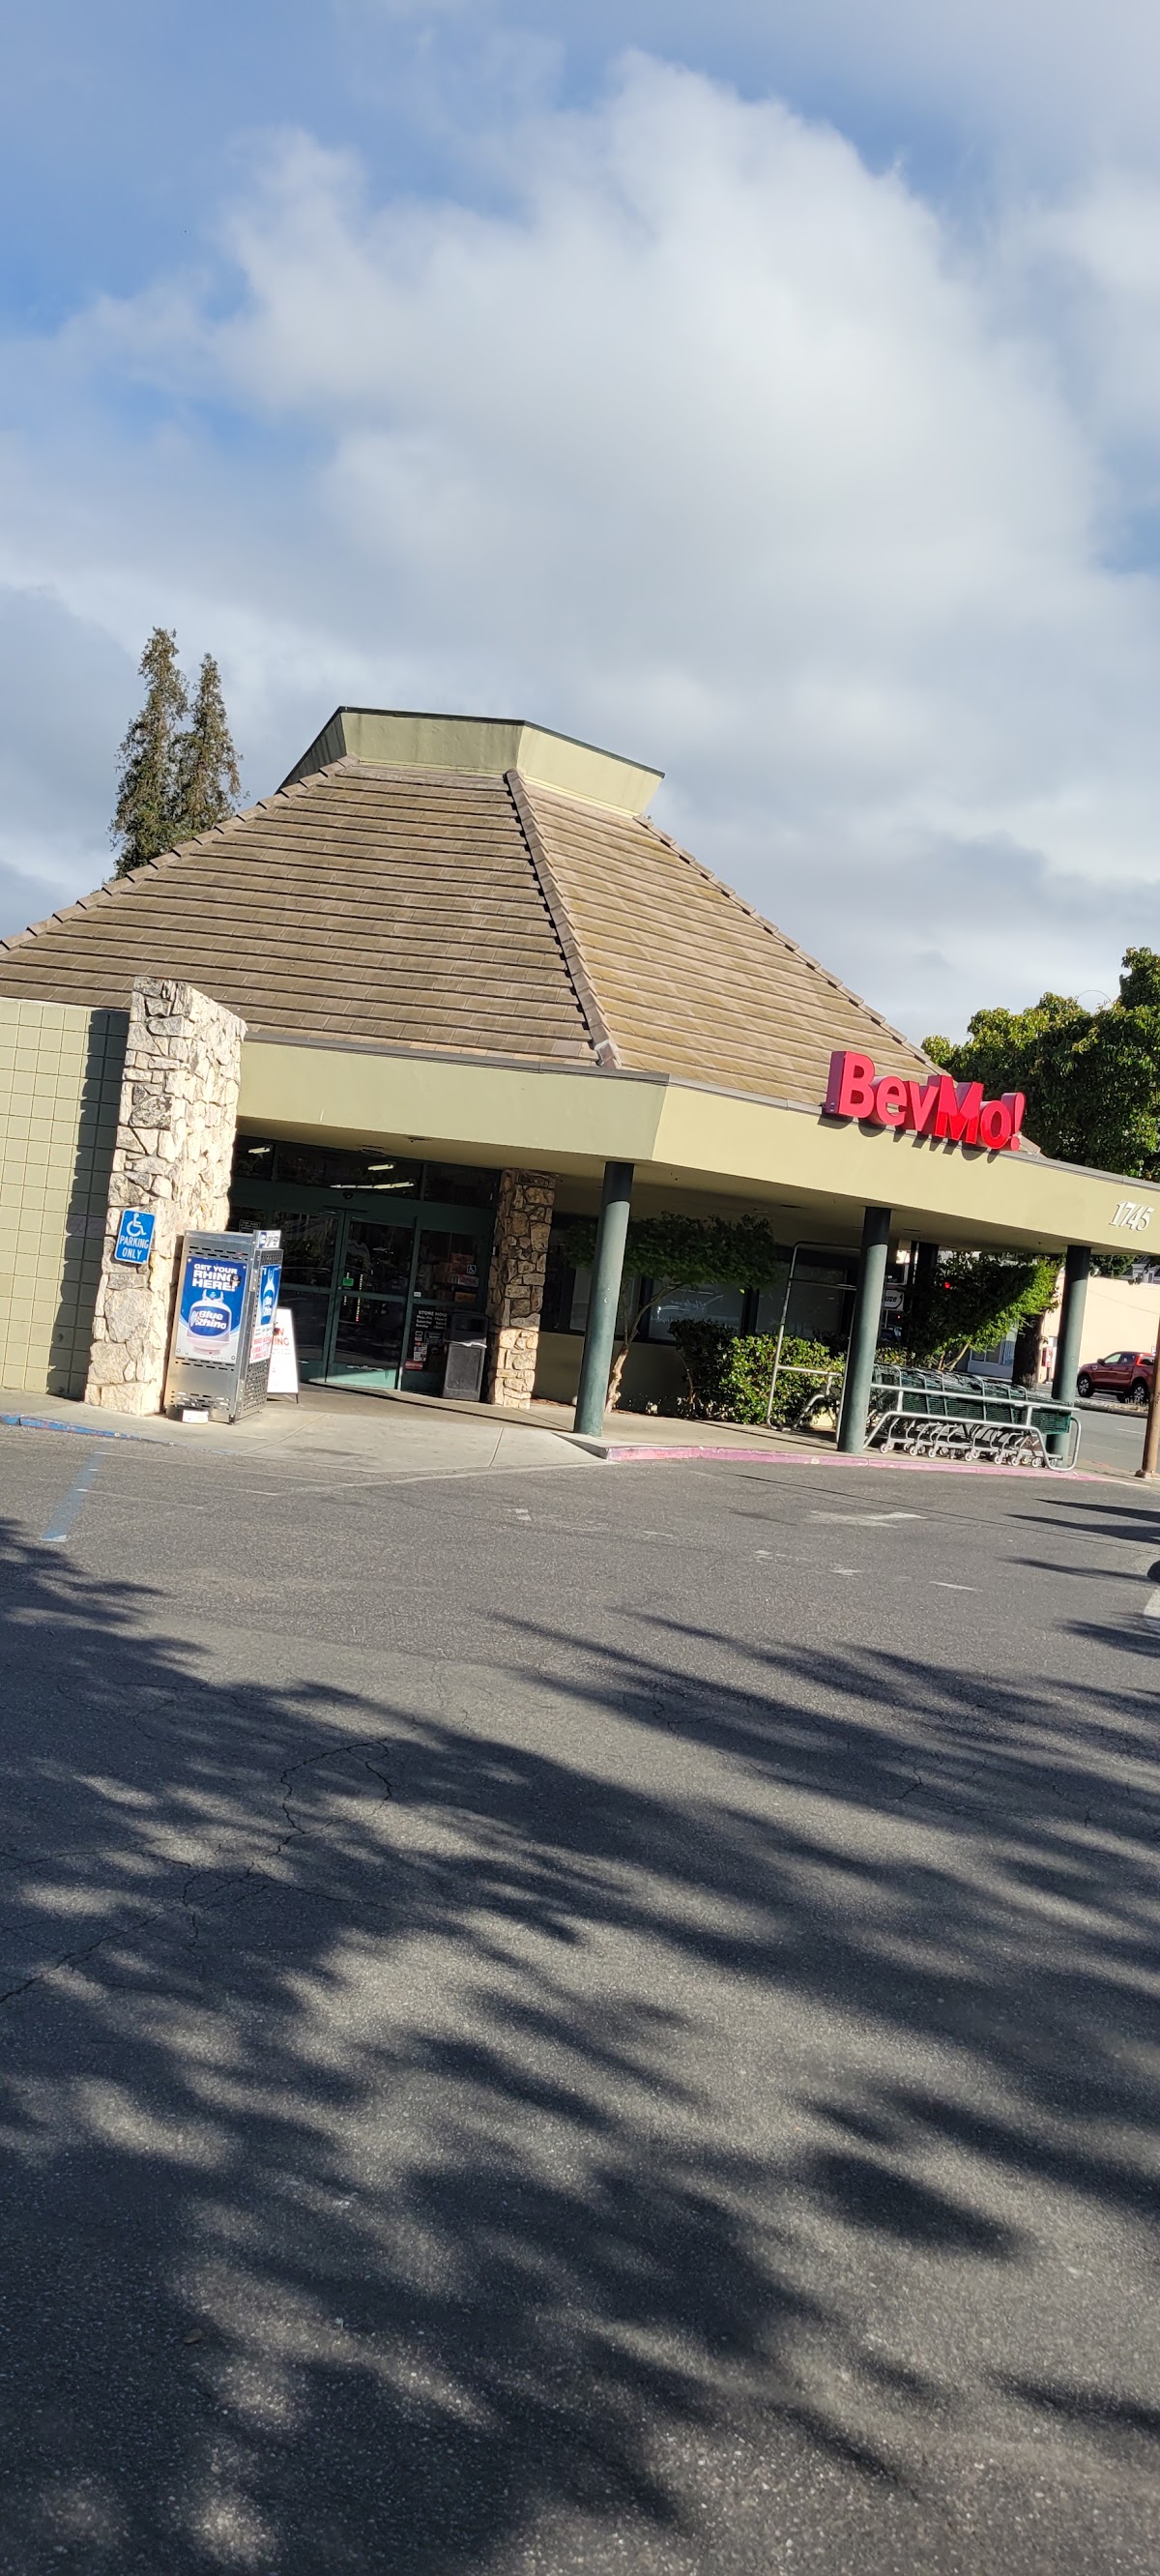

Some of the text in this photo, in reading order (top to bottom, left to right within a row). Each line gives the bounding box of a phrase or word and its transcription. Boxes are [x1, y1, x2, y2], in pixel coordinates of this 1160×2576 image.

[826, 1051, 1026, 1152] BevMo!
[1109, 1201, 1155, 1231] 1745
[119, 1235, 150, 1249] PARKING
[122, 1247, 142, 1260] ONLY
[213, 1266, 238, 1274] YOUR
[199, 1310, 223, 1321] Blue
[195, 1318, 227, 1330] Rhino
